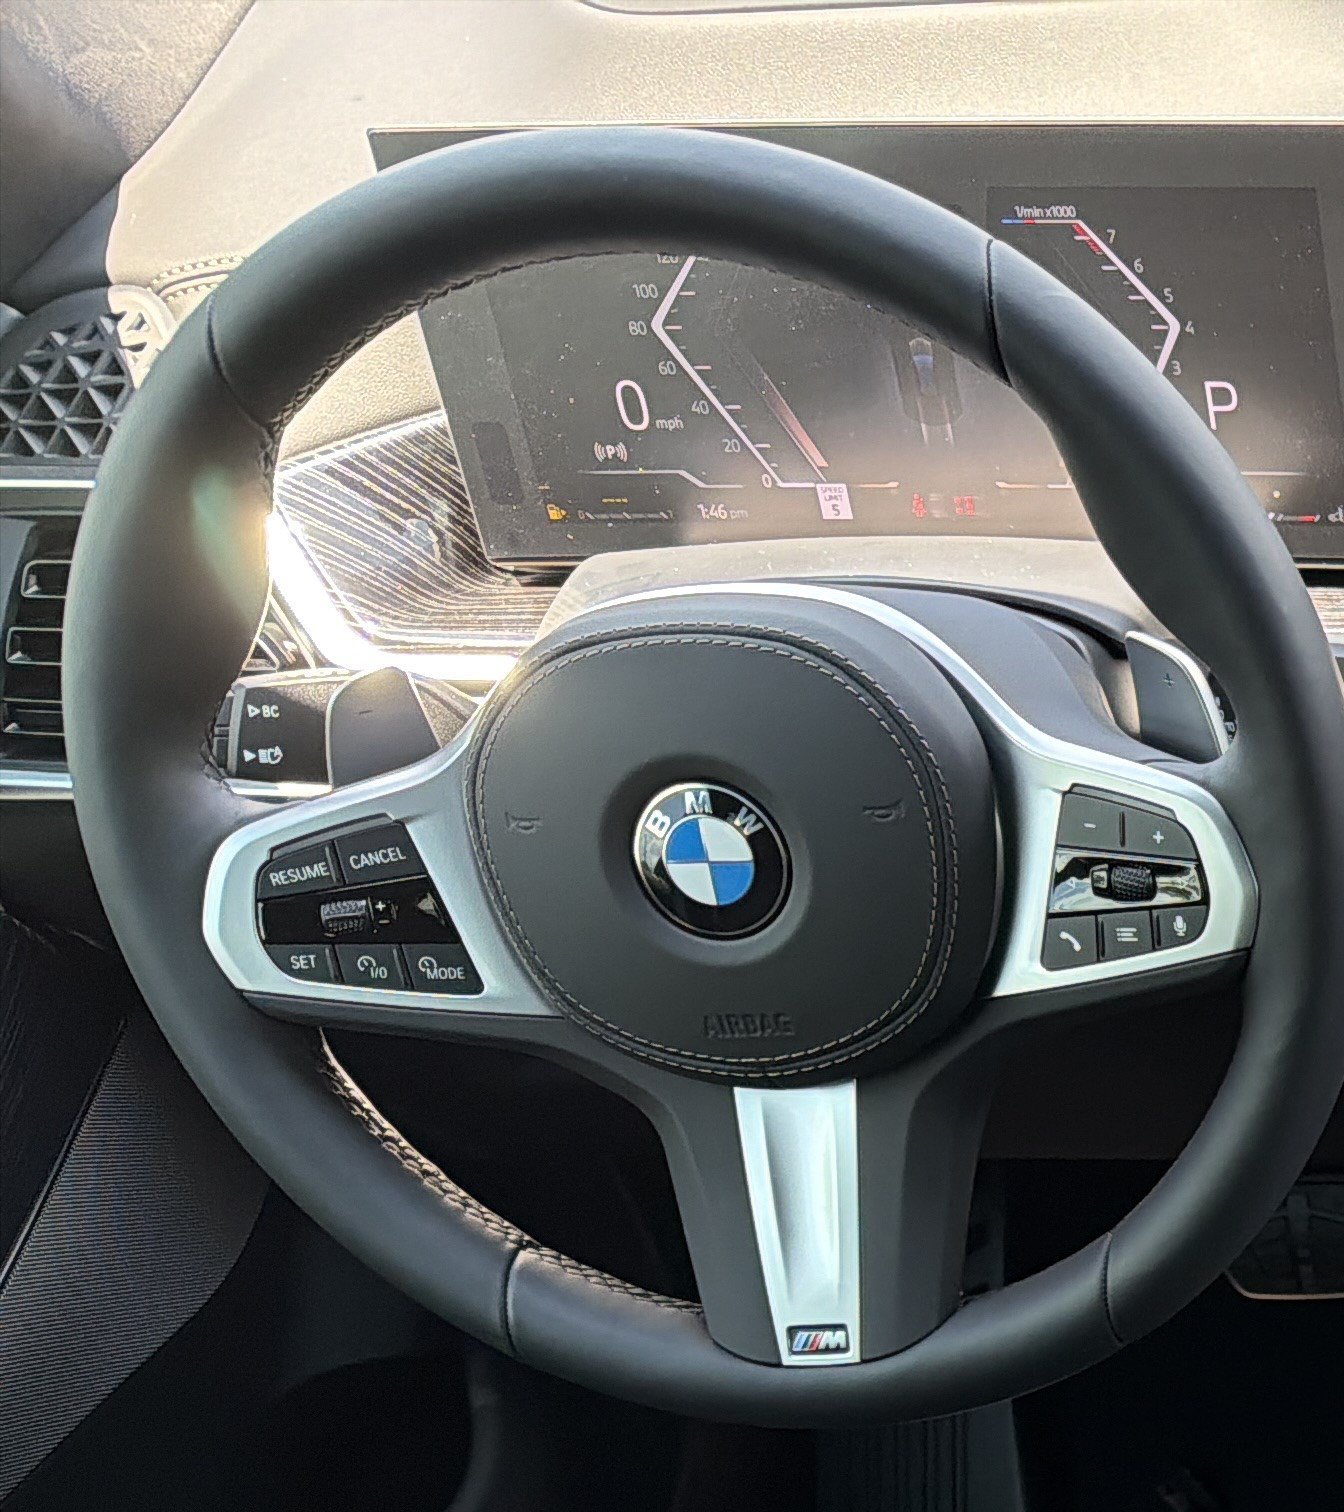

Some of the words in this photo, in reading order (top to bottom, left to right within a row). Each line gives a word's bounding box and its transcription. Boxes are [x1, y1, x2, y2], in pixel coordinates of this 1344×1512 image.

[1106, 229, 1117, 244] 7
[1133, 258, 1144, 274] 6
[632, 283, 658, 299] 100
[1163, 288, 1174, 303] 5
[628, 320, 648, 336] 80
[1184, 320, 1196, 336] 4
[658, 361, 677, 376] 60
[1171, 360, 1182, 376] 3
[614, 379, 650, 431] 0
[691, 400, 710, 415] 40
[1203, 381, 1239, 430] P
[655, 415, 684, 431] mph
[721, 438, 741, 453] 20
[761, 473, 772, 489] 0
[696, 503, 728, 520] 1:46
[644, 790, 765, 838] BMW
[349, 846, 407, 870] CANCEL
[268, 862, 330, 887] RESUME
[290, 954, 317, 970] SET
[426, 966, 466, 981] MODE
